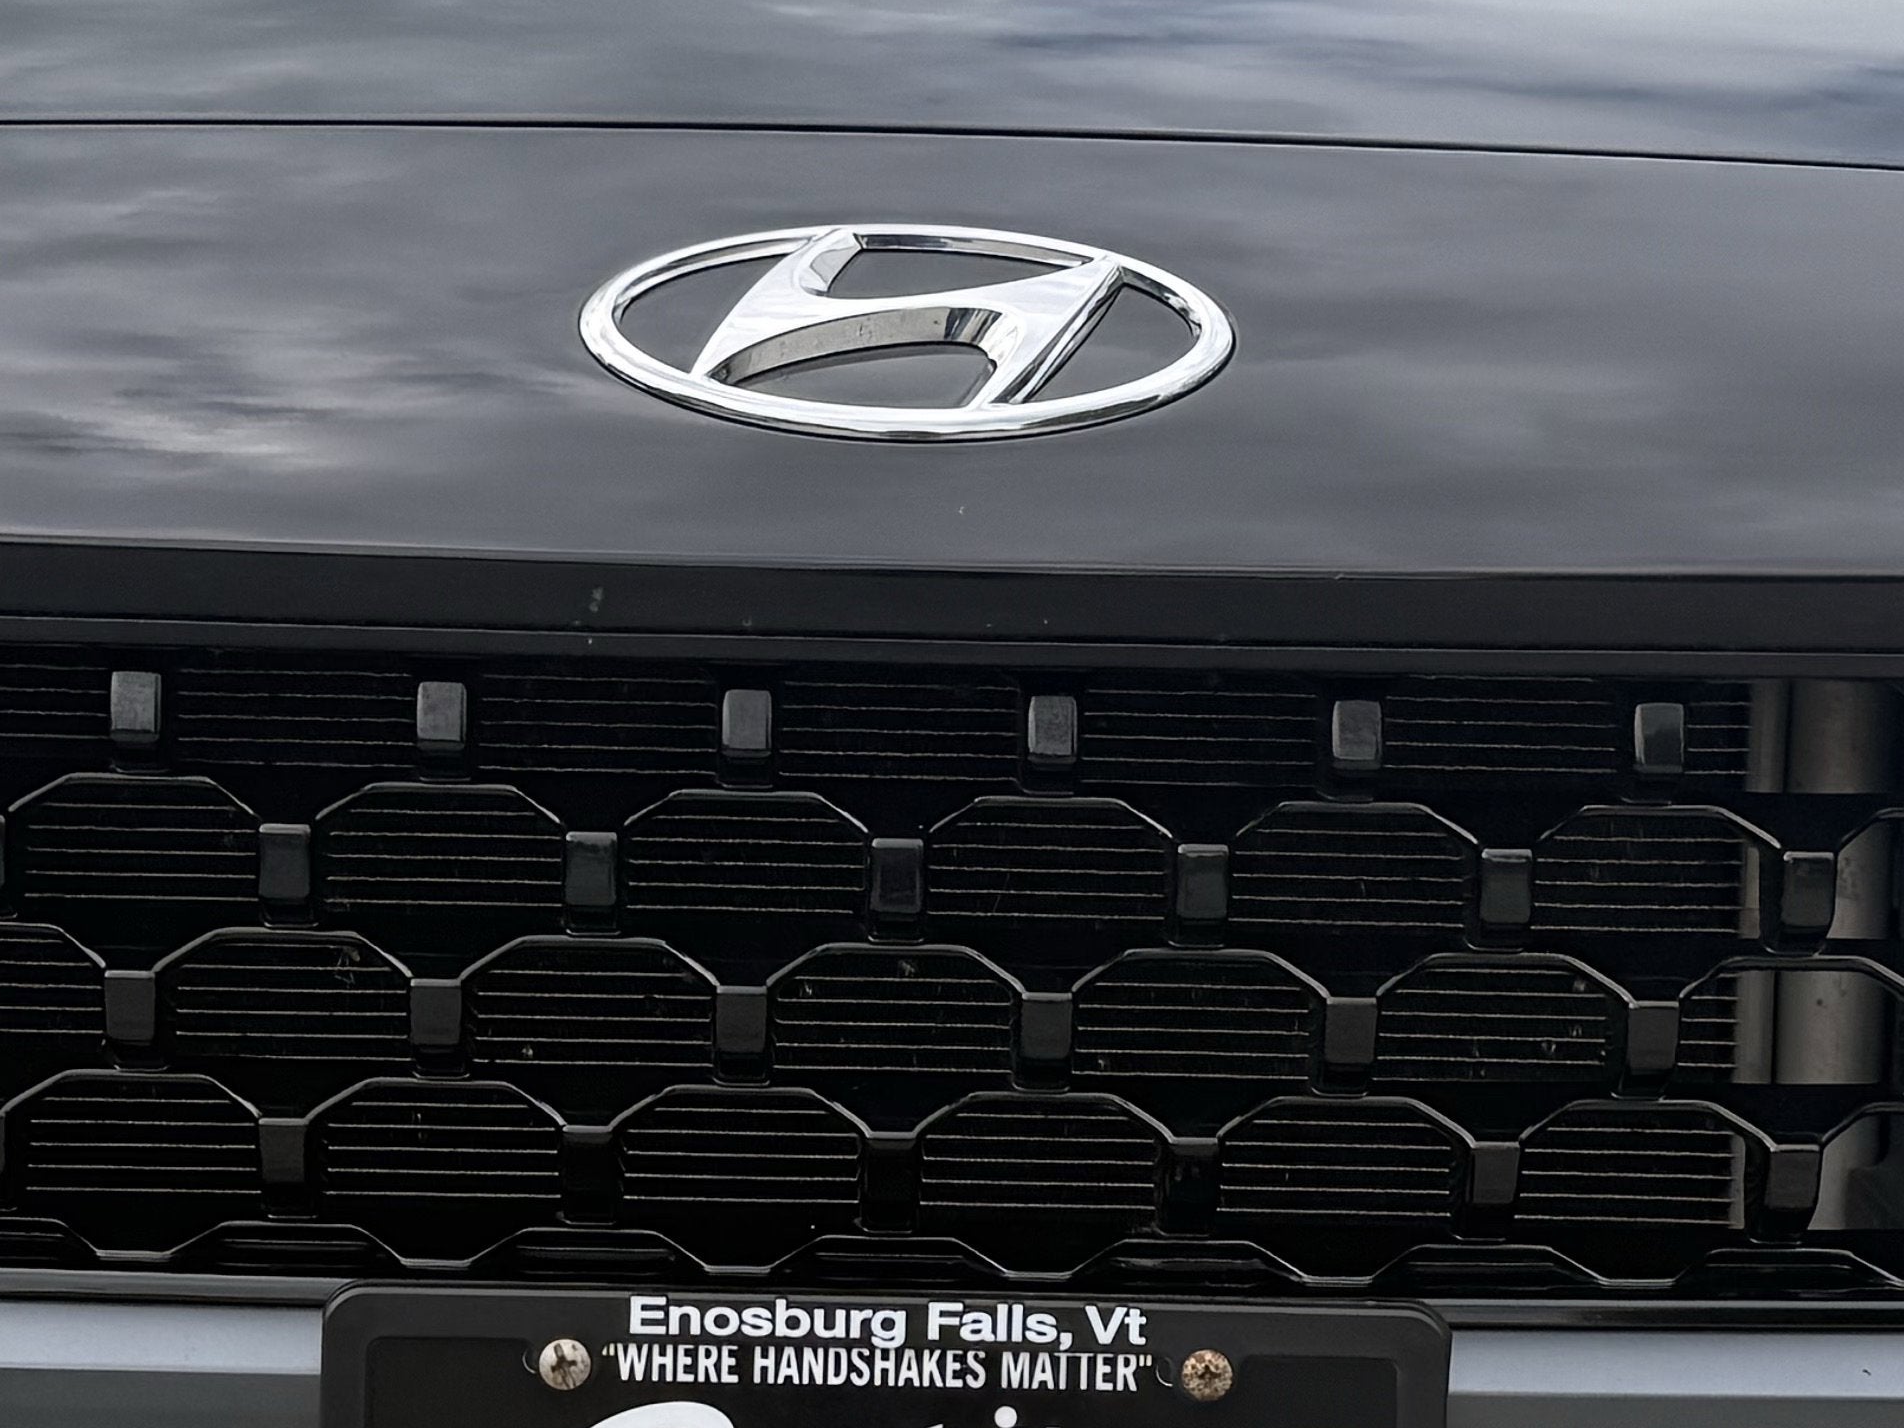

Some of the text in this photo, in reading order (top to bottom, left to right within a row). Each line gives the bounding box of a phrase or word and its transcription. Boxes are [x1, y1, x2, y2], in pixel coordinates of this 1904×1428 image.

[629, 1295, 1147, 1351] Enosburg Falls, Vt
[753, 1346, 986, 1389] HANDSHAKES
[1001, 1351, 1152, 1392] MATTER"
